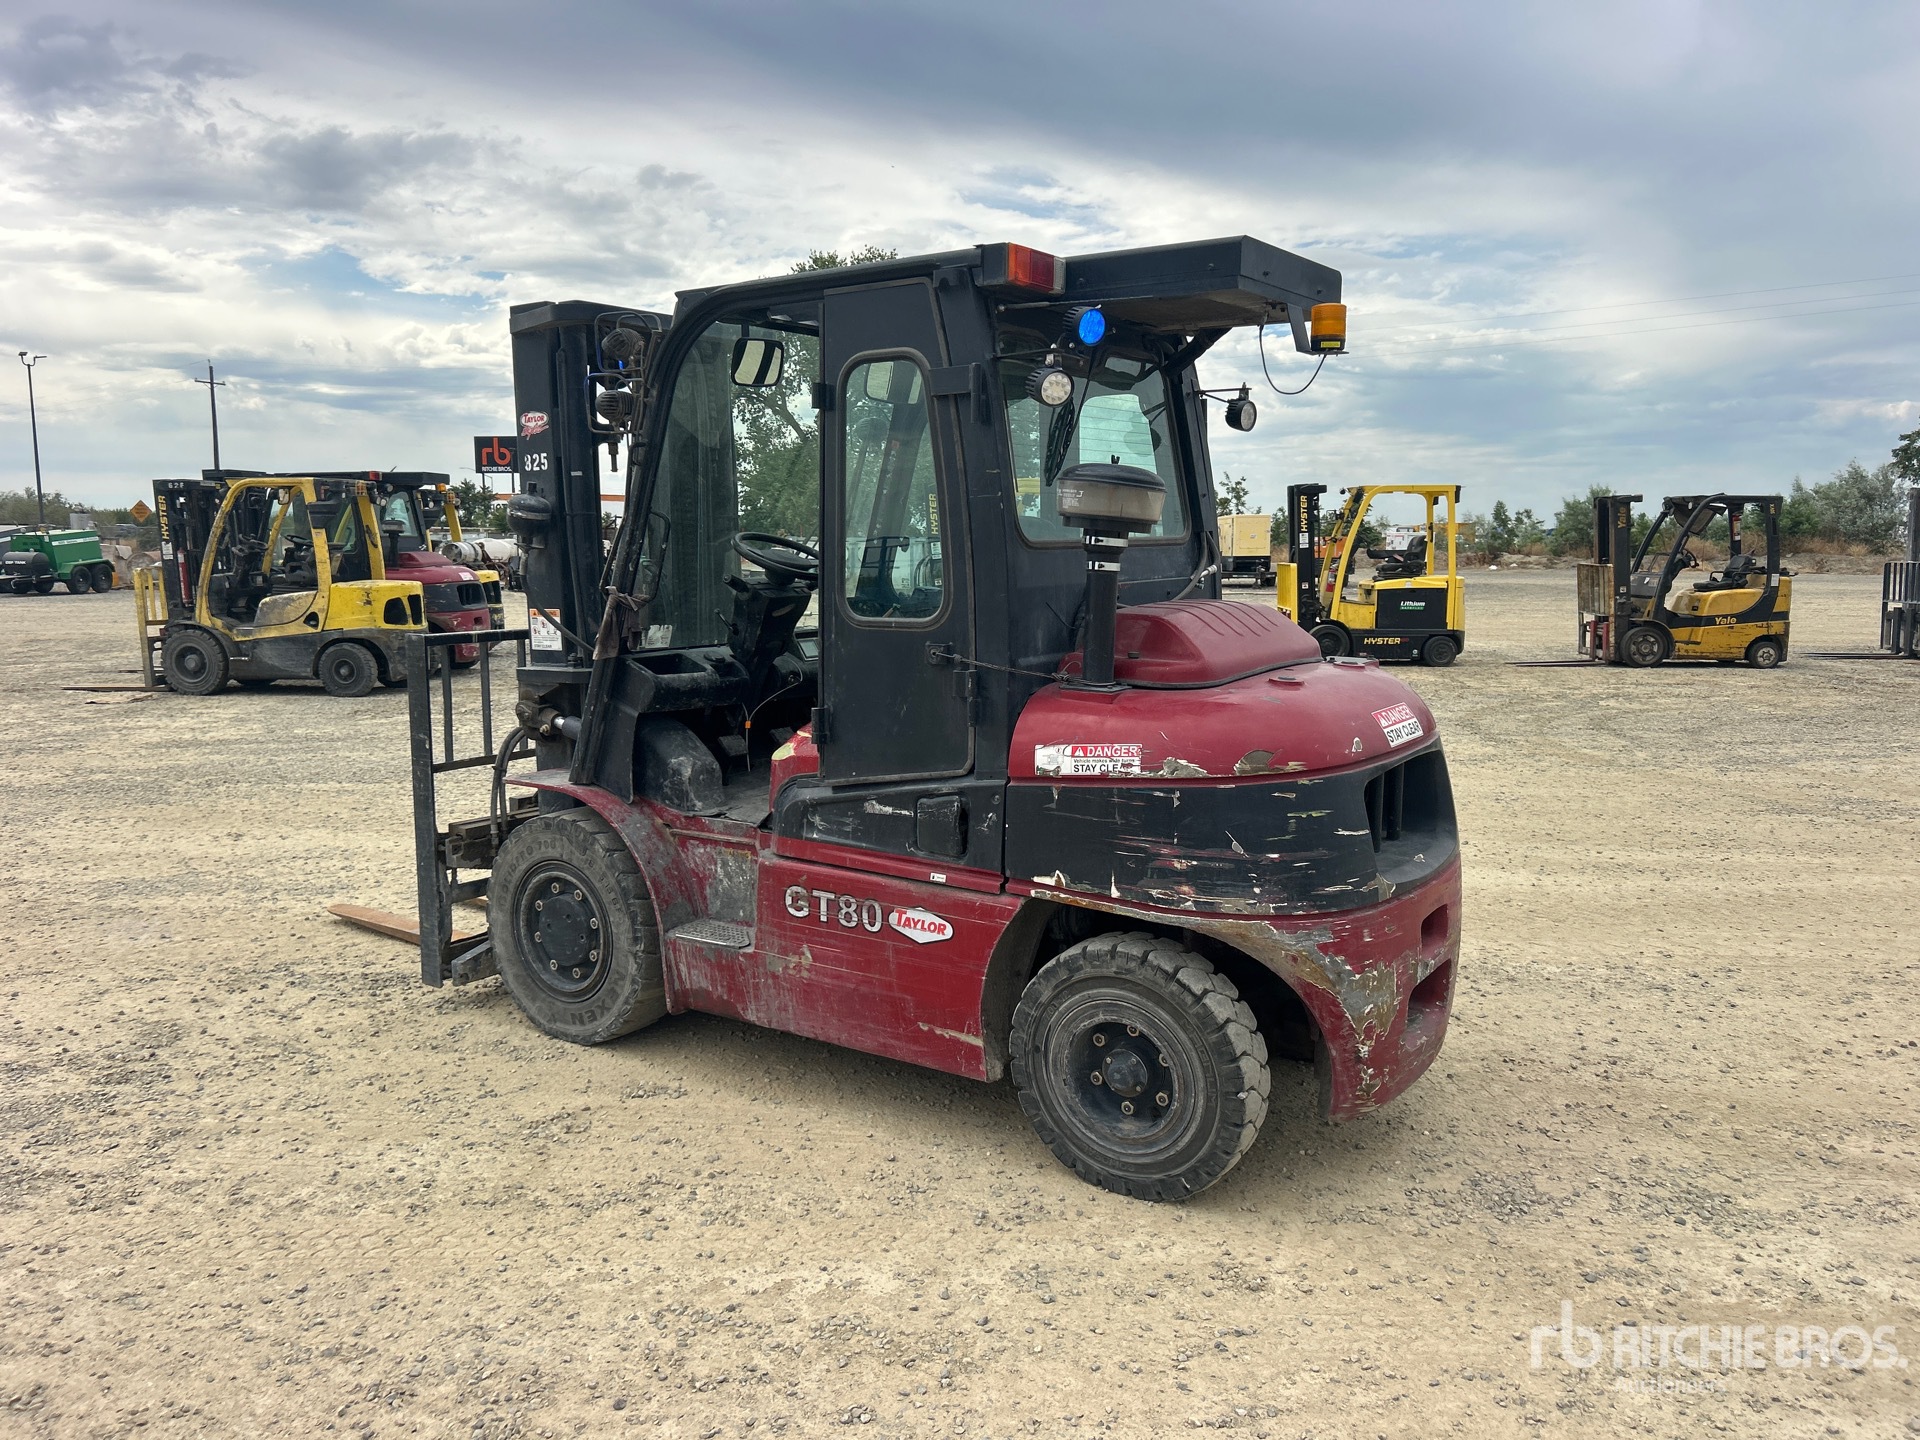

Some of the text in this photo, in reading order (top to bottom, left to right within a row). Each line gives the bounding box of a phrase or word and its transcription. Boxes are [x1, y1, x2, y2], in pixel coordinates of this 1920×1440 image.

[523, 413, 545, 423] TAYLOR
[481, 438, 511, 465] rb
[158, 495, 170, 540] HYSTER
[929, 493, 939, 535] HYSTER
[1300, 495, 1308, 532] HYSTER
[1617, 506, 1627, 529] Yale
[1715, 616, 1737, 625] Yale
[1363, 637, 1401, 645] HYSTER
[1386, 727, 1404, 743] STAY
[1087, 745, 1138, 757] DANGER
[1073, 763, 1122, 773] STAY CLE
[785, 885, 883, 933] GT80
[894, 908, 947, 936] TAYLOR
